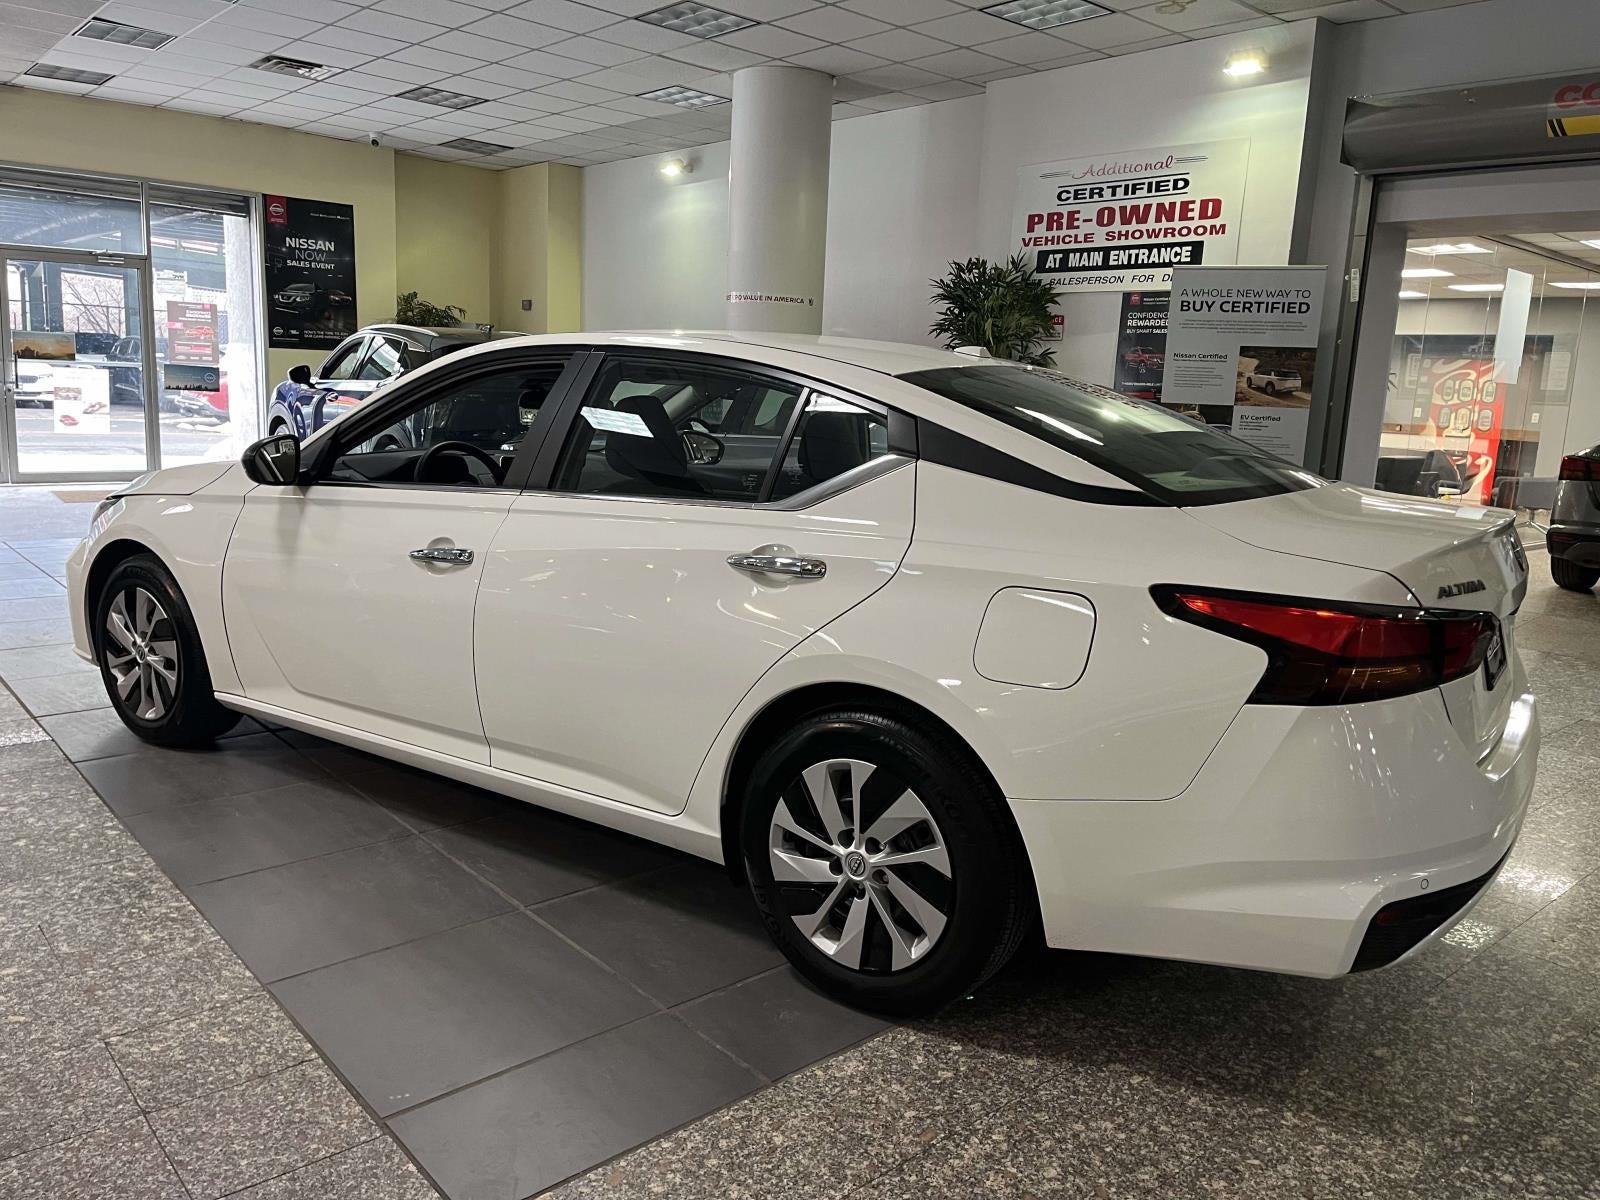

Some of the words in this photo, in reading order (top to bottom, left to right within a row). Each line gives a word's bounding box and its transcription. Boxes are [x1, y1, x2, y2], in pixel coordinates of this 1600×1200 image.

[1072, 155, 1174, 180] Additional
[1056, 177, 1190, 202] CERTIFIED
[1026, 198, 1223, 234] PRE-OWNED
[1021, 233, 1095, 248] VEHICLE
[1105, 223, 1227, 242] SHOWROOM
[285, 236, 335, 252] NISSAN
[295, 249, 327, 261] NOW
[1045, 253, 1062, 269] AT
[1068, 251, 1103, 268] MAIN
[1108, 246, 1193, 266] ENTRANCE
[286, 259, 310, 268] SALES
[311, 262, 336, 270] EVENT
[1049, 276, 1125, 287] SALESPERSON
[1131, 274, 1155, 284] FOR
[773, 296, 805, 305] AMERICA
[1180, 288, 1189, 298] A
[1191, 288, 1234, 298] WHOLE
[1236, 288, 1264, 299] NEW
[1265, 289, 1292, 299] WAY
[1295, 289, 1312, 299] TO
[1127, 311, 1170, 319] CONFIDENC
[1180, 300, 1216, 313] BUY
[1219, 300, 1311, 315] CERTIFIED
[1437, 579, 1487, 600] ALTIMA
